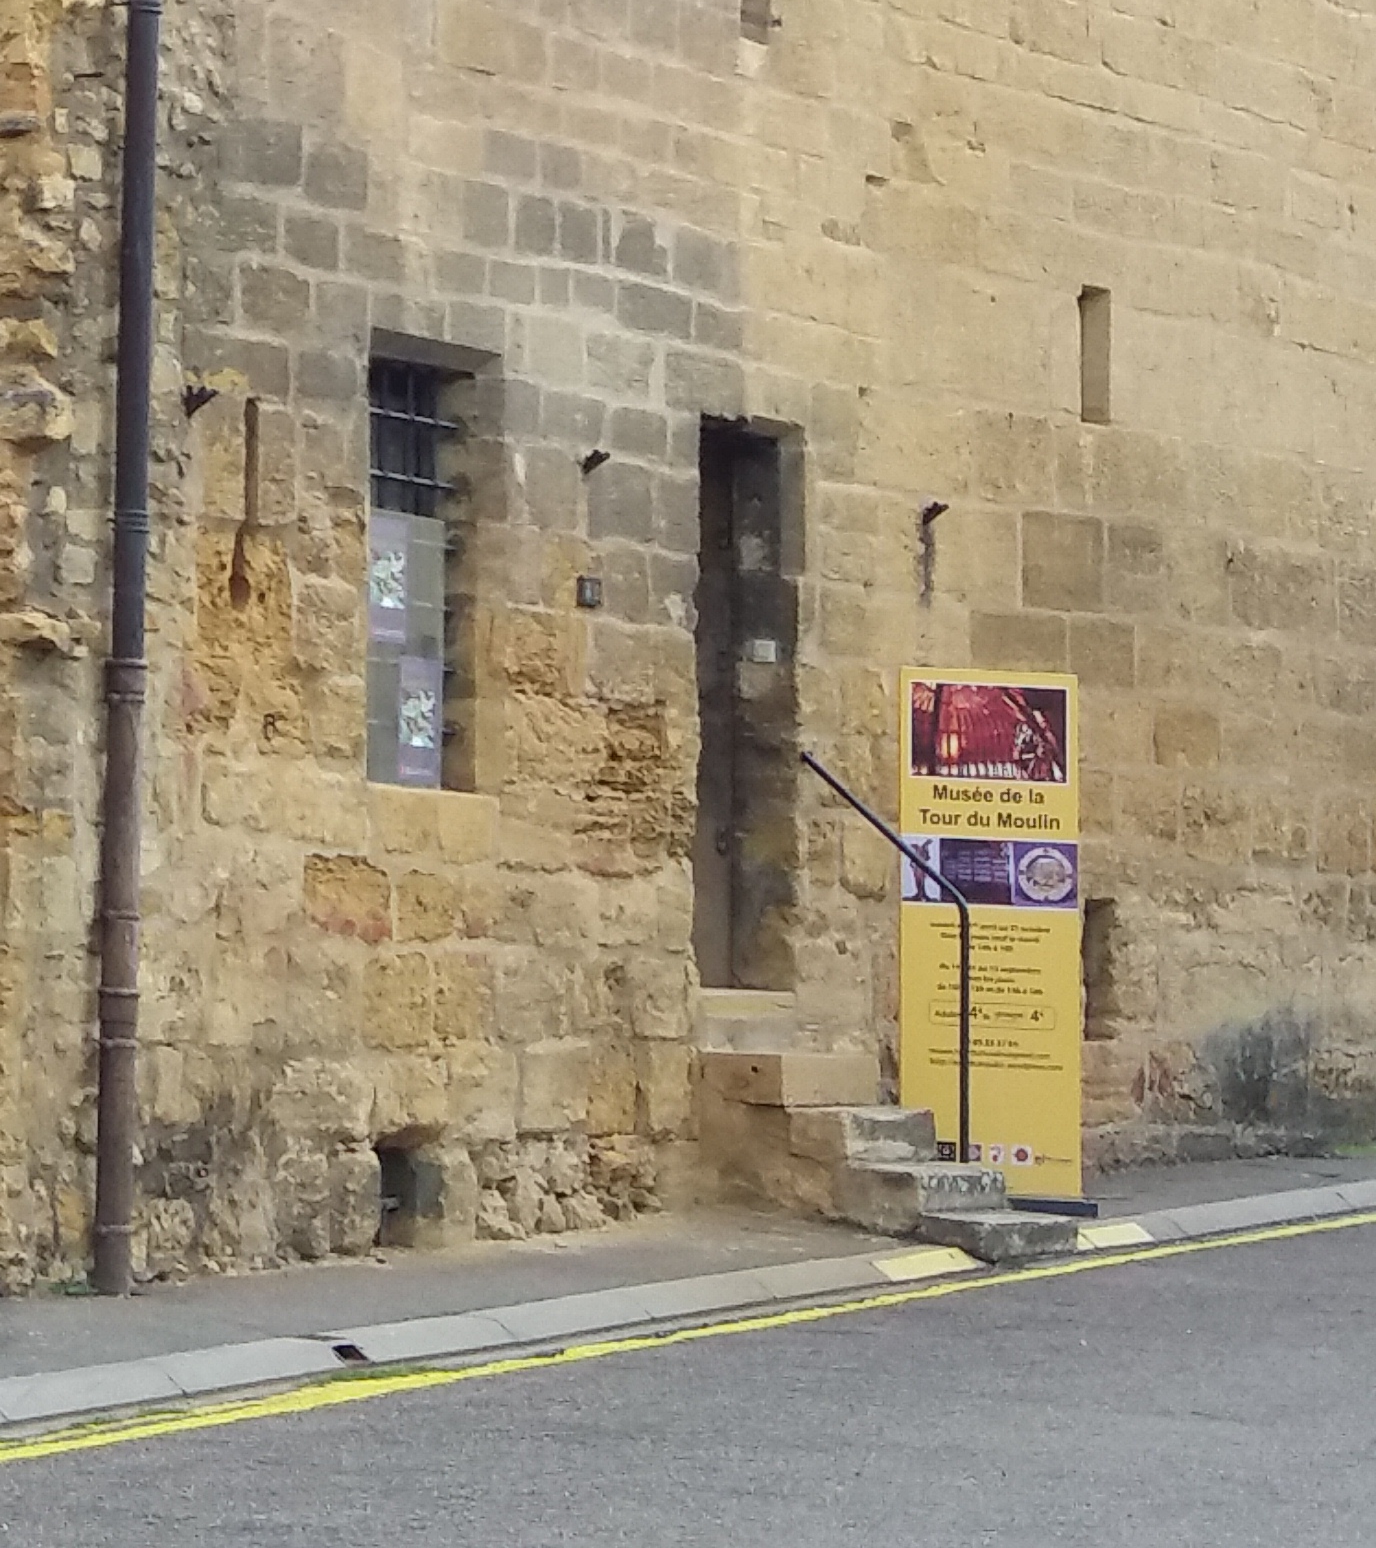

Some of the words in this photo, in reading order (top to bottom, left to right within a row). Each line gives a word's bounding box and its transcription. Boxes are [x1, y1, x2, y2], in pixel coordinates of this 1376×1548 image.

[932, 784, 994, 803] Musée
[999, 788, 1023, 804] de
[1029, 788, 1046, 805] la
[919, 808, 962, 826] Tour
[966, 811, 991, 828] du
[997, 812, 1061, 830] Moulin
